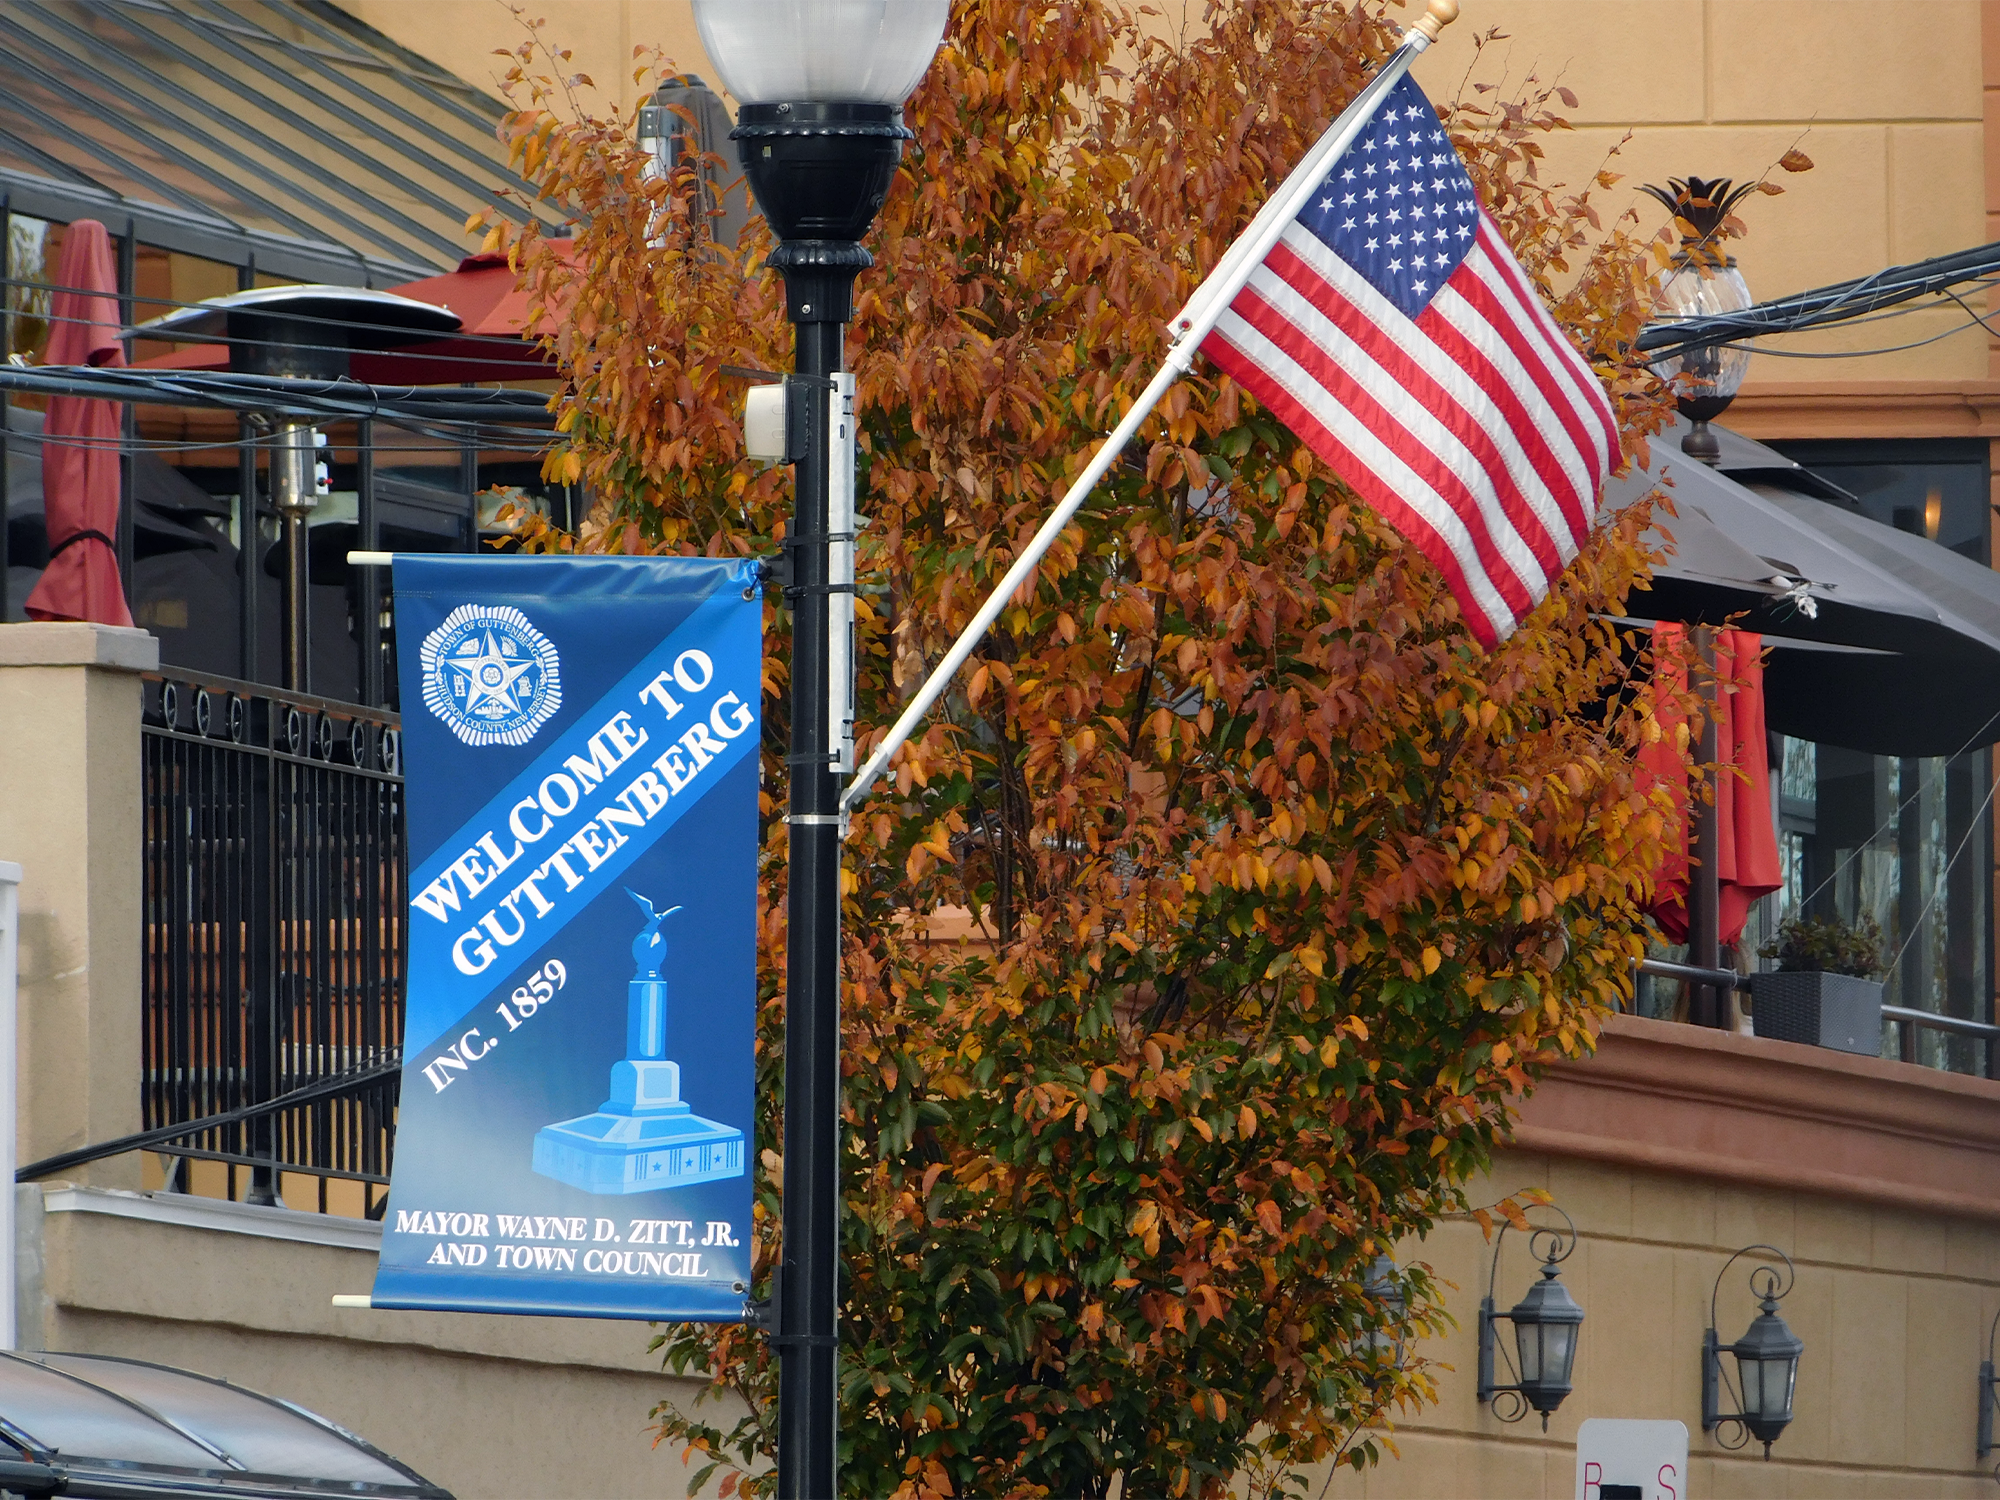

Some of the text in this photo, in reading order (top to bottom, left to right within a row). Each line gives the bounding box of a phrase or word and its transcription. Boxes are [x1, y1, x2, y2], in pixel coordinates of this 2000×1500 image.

[439, 629, 464, 655] TOWN
[464, 621, 476, 632] OF
[478, 619, 540, 656] GUTTENBERG
[438, 685, 465, 721] HUDSON
[508, 713, 529, 729] NEW
[527, 686, 547, 716] JERSEY
[411, 649, 714, 924] WELCOME TO
[451, 691, 755, 976] GUTTENBERG
[421, 958, 567, 1094] INC. 1859
[394, 1210, 740, 1249] MAYOR WAYNE D. ZITT, JR.
[427, 1242, 709, 1278] AND TOWN COUNCIL
